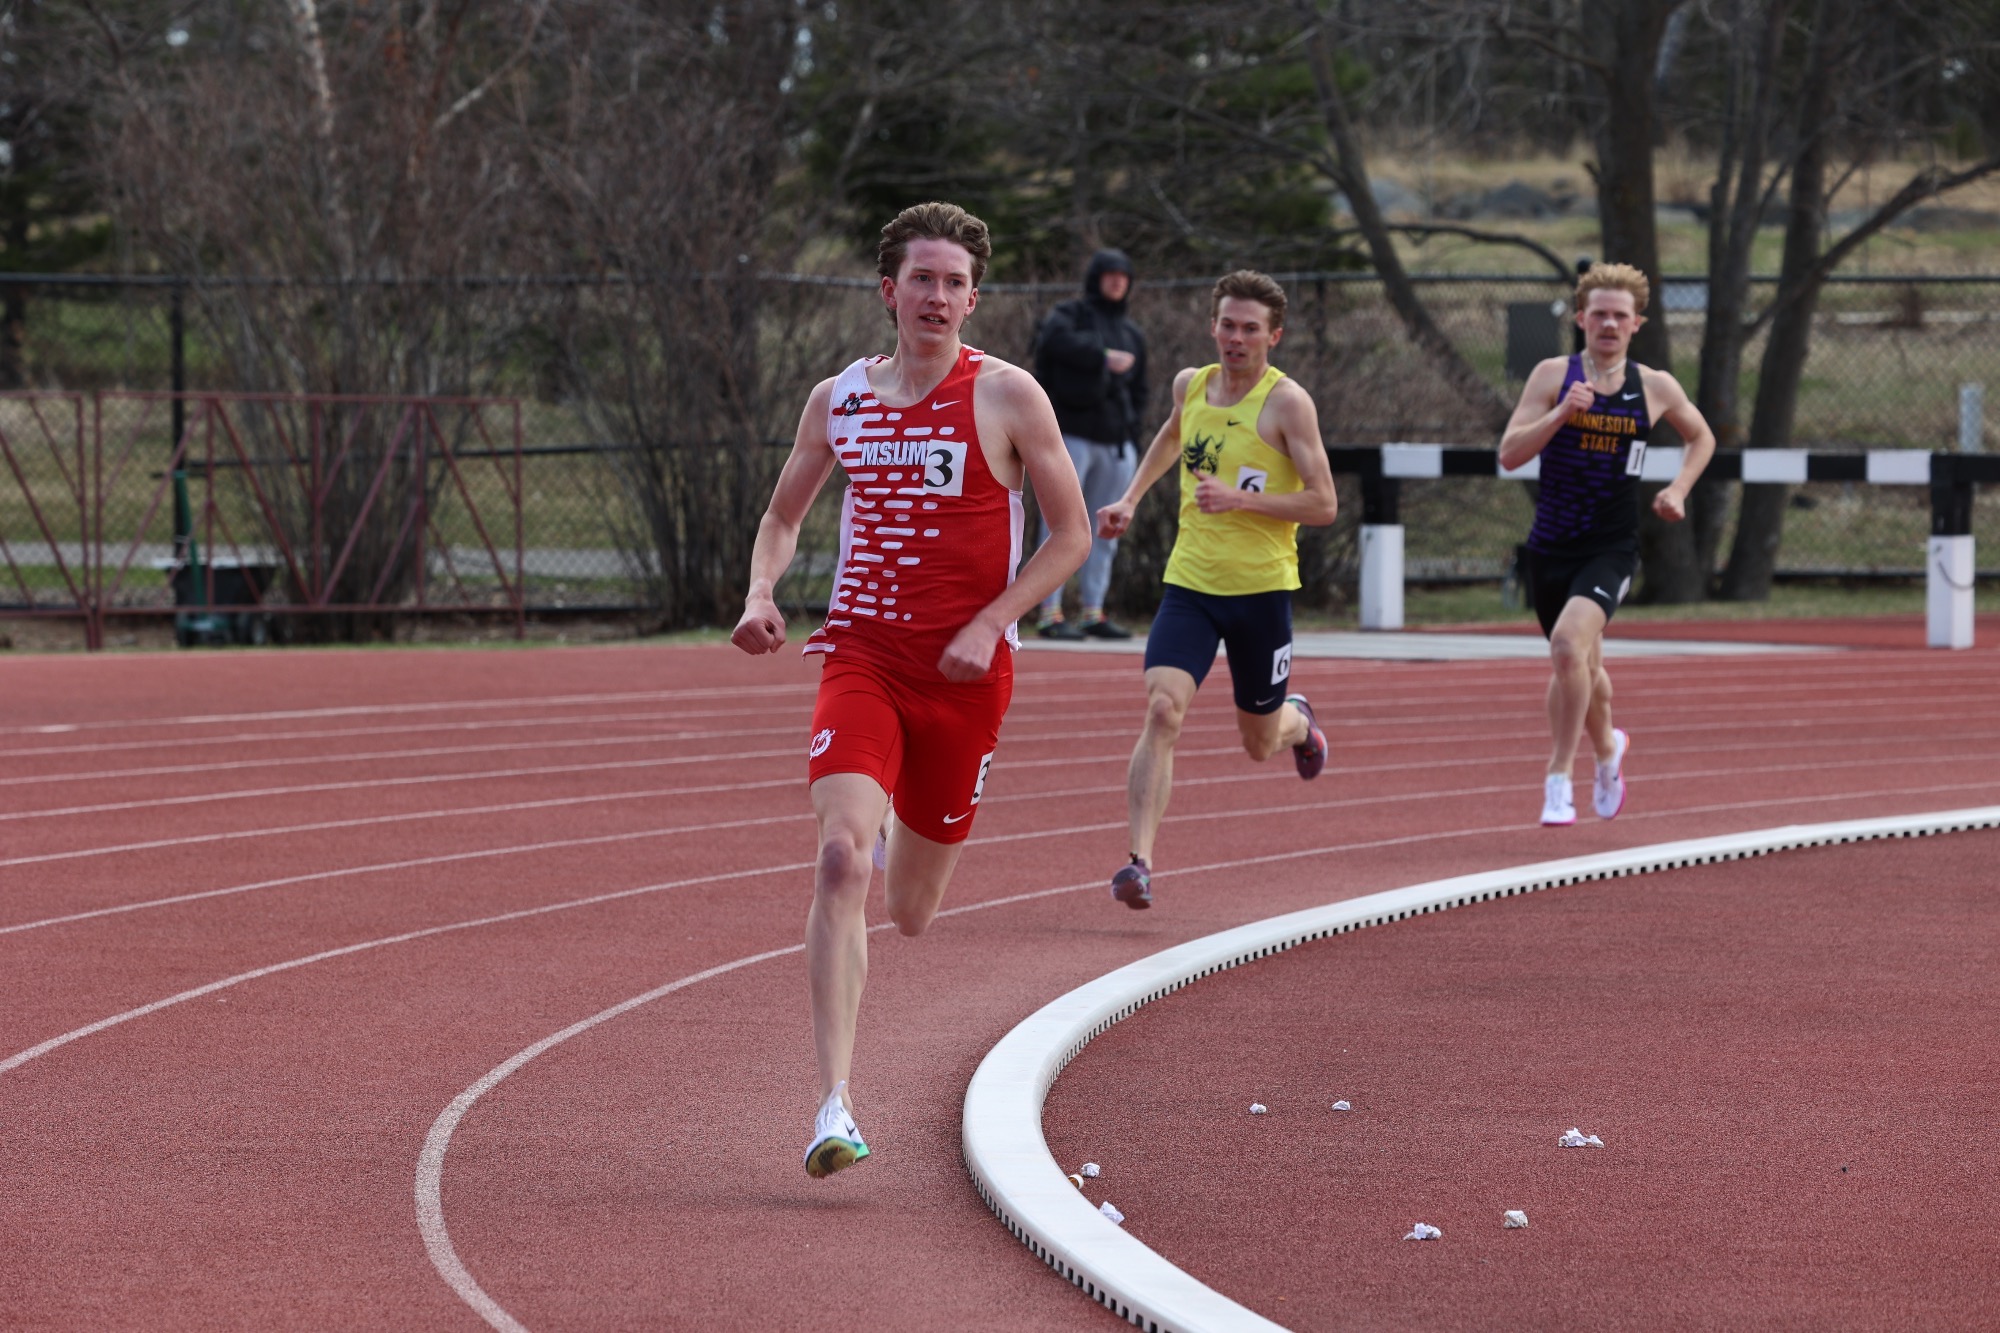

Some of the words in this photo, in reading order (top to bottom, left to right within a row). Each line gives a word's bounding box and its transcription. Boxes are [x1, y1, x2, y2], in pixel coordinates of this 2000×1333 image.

[1568, 412, 1636, 434] MINNESOTA
[860, 441, 927, 466] MSUM
[1580, 432, 1618, 453] STATE
[924, 448, 953, 487] 3
[1240, 474, 1264, 494] 6
[1277, 649, 1289, 676] 6
